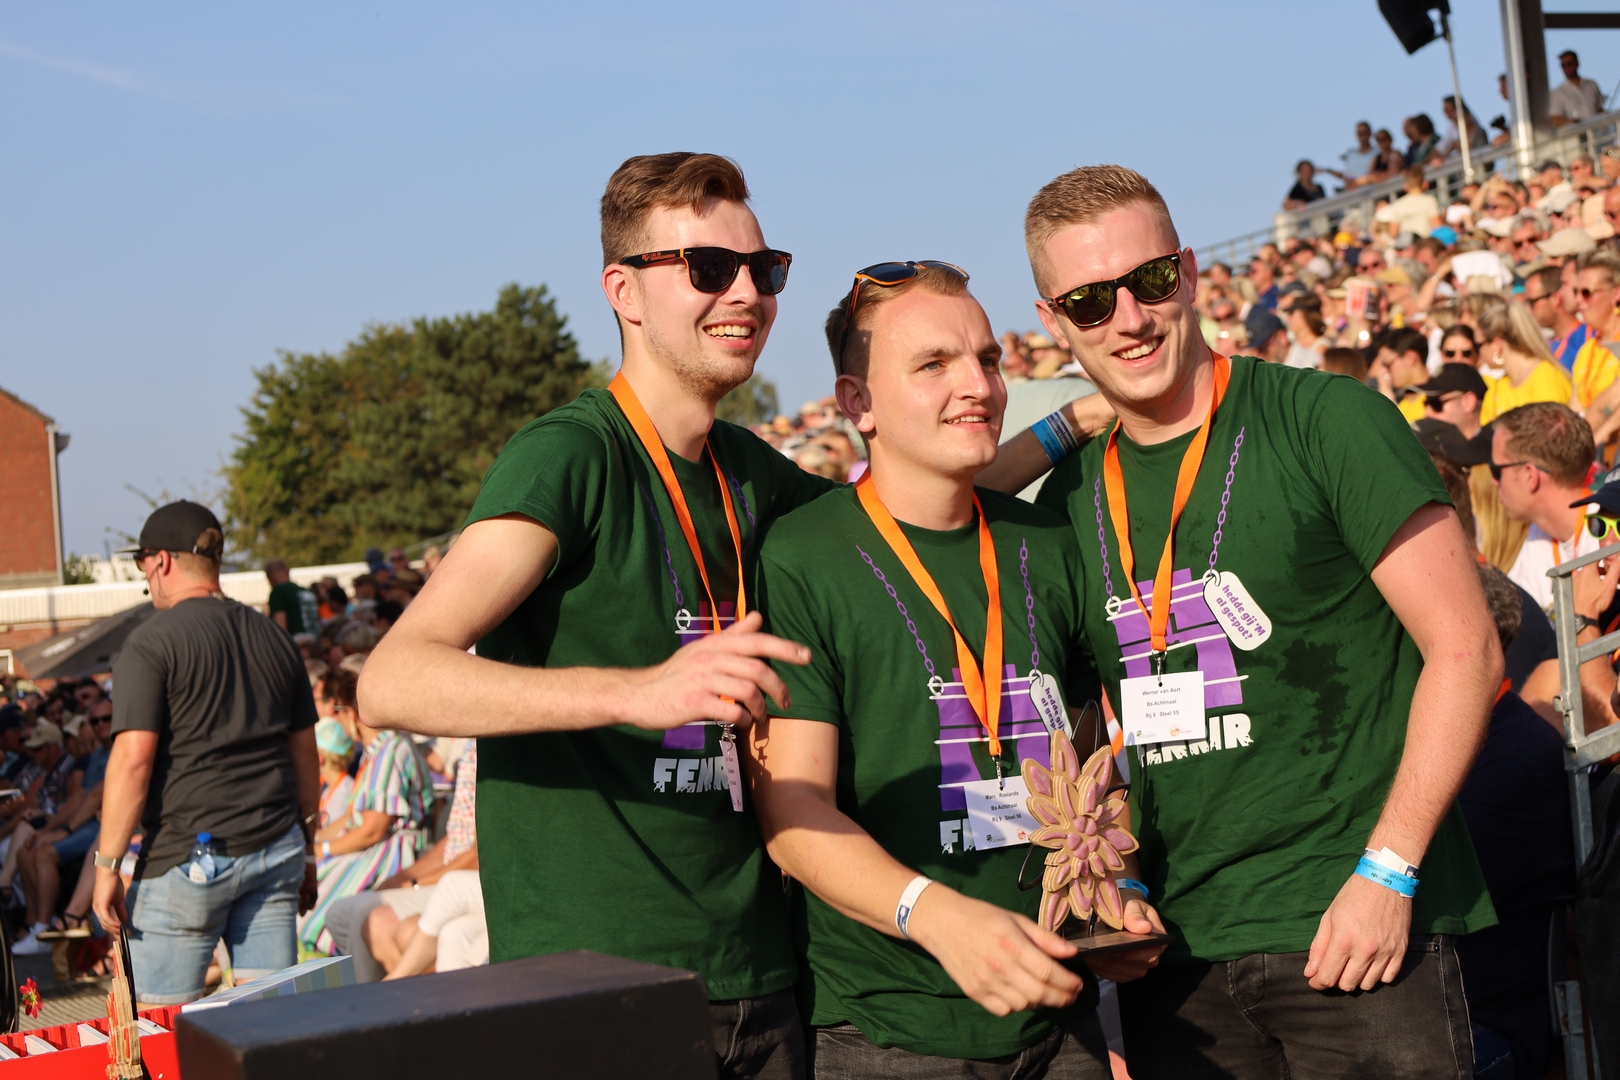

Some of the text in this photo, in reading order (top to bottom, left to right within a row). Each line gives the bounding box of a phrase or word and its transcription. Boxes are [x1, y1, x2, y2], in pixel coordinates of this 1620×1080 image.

[1216, 597, 1253, 639] al gespot?
[1222, 584, 1266, 636] hedde gij 'M
[1041, 697, 1057, 730] al gesp
[1045, 687, 1064, 730] hedde gij
